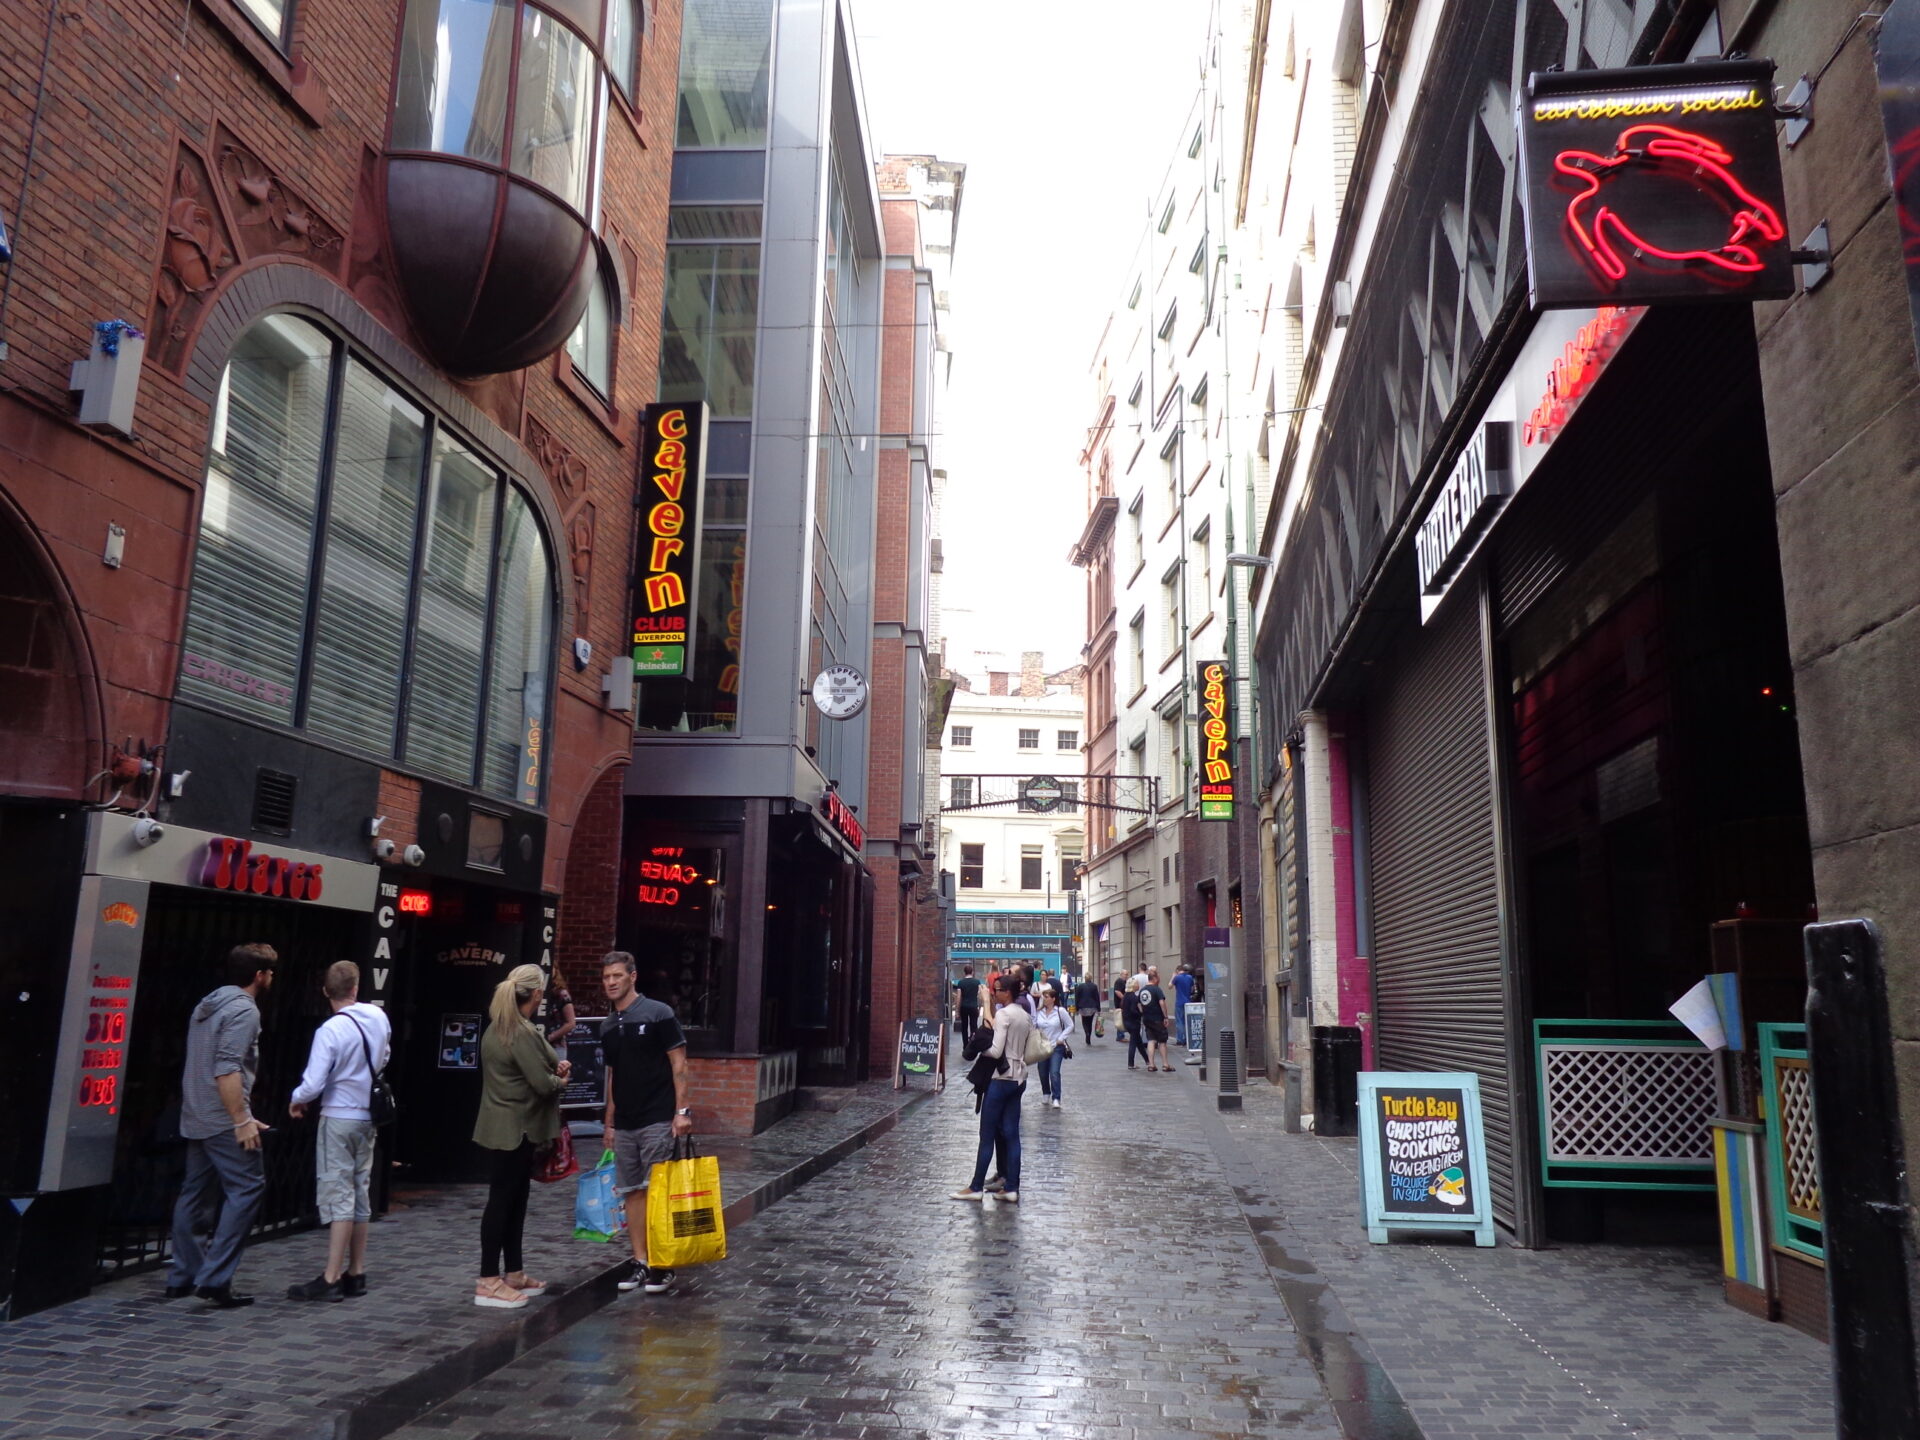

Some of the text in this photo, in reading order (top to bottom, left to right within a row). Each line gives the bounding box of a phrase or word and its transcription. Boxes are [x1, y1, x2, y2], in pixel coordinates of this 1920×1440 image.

[1534, 90, 1763, 121] caribbean social
[644, 409, 688, 613] cavern
[635, 617, 685, 631] CLUB
[636, 660, 679, 671] Heineken
[183, 653, 291, 706] CRICKET
[1203, 664, 1232, 784] cavern
[1202, 785, 1232, 794] PUB
[381, 883, 398, 898] THE
[544, 907, 555, 918] THE
[437, 947, 506, 965] CAVERN
[85, 1012, 125, 1043] BIG
[902, 1031, 939, 1043] LIVE MUSIC
[79, 1075, 116, 1106] Out
[1382, 1096, 1458, 1120] Turtle Bay
[1386, 1120, 1457, 1140] CHRISTMAS
[1388, 1134, 1460, 1159] BOOKINGS
[1389, 1150, 1463, 1176] NOW BEING TAKEN
[1391, 1173, 1430, 1189] ENQUIRE
[1393, 1188, 1428, 1201] INSIDE
